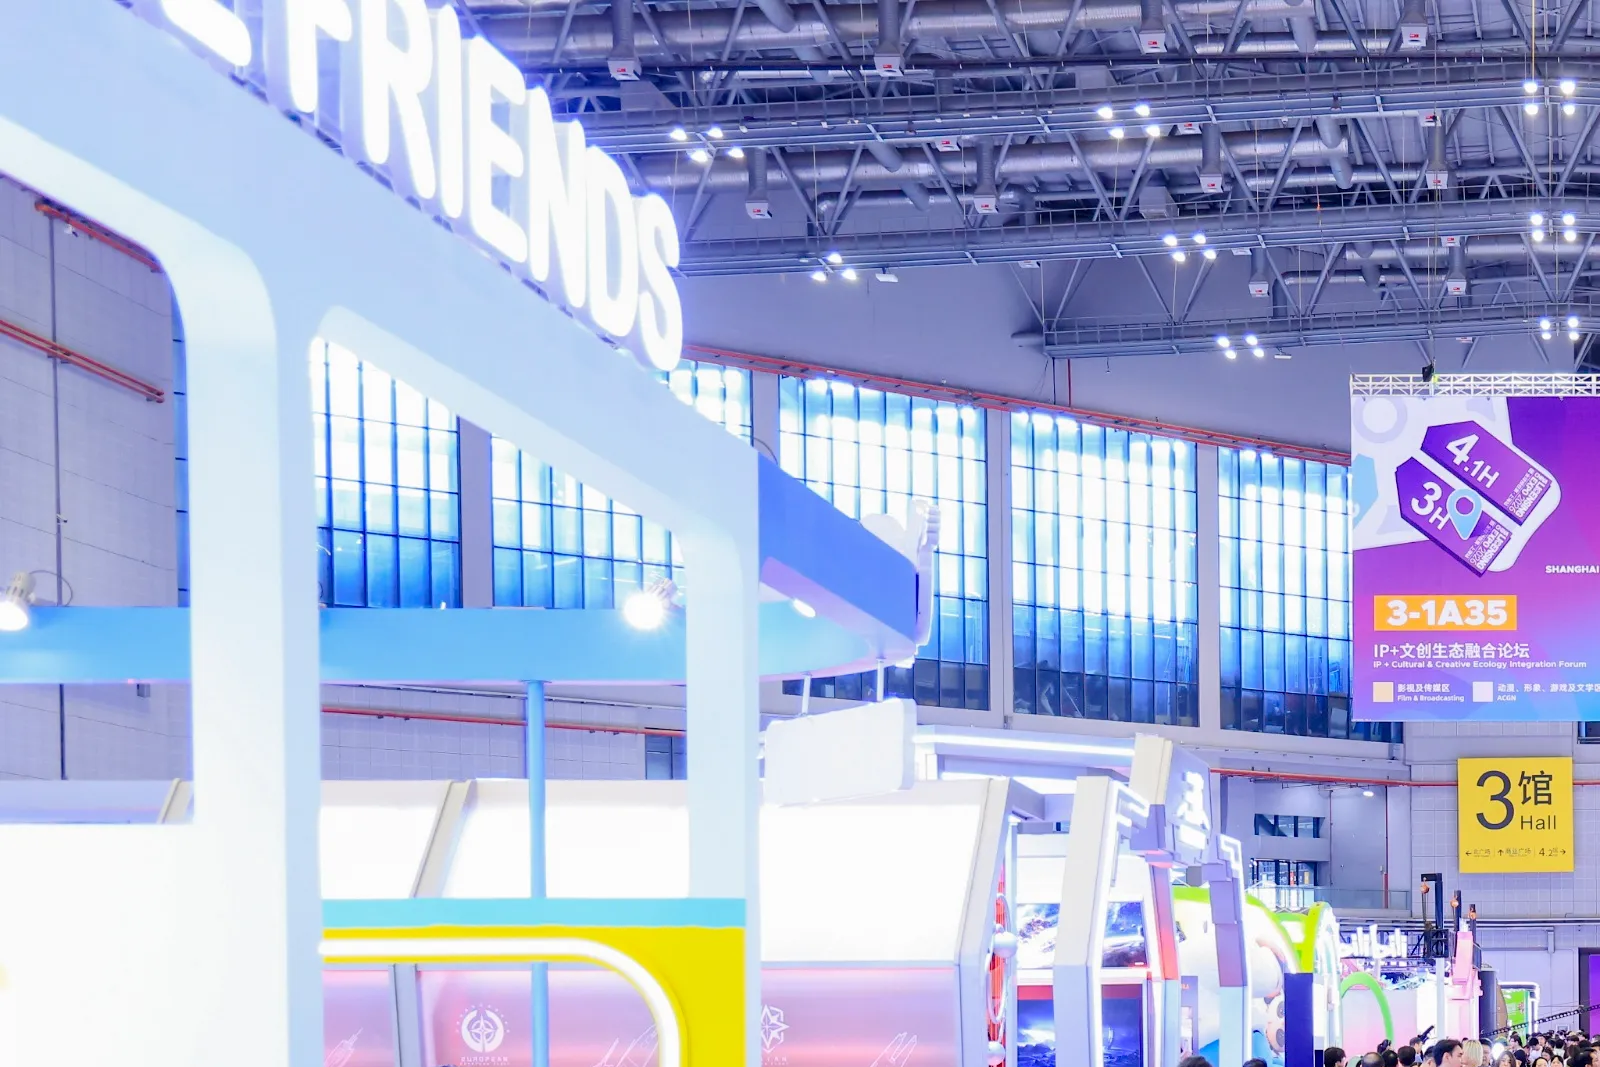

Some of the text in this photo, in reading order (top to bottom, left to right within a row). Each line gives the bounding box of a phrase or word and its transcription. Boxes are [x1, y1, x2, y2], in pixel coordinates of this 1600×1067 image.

[286, 0, 682, 371] FRIENDS
[1545, 565, 1599, 574] SHANGHAI
[1387, 599, 1508, 627] 3-1A35
[1374, 643, 1530, 659] IP+文创生态融合论坛
[1392, 660, 1425, 668] Cultural
[1435, 660, 1471, 668] Creative
[1473, 660, 1507, 670] Ecology
[1510, 660, 1557, 669] Integration
[1520, 815, 1556, 830] Hall
